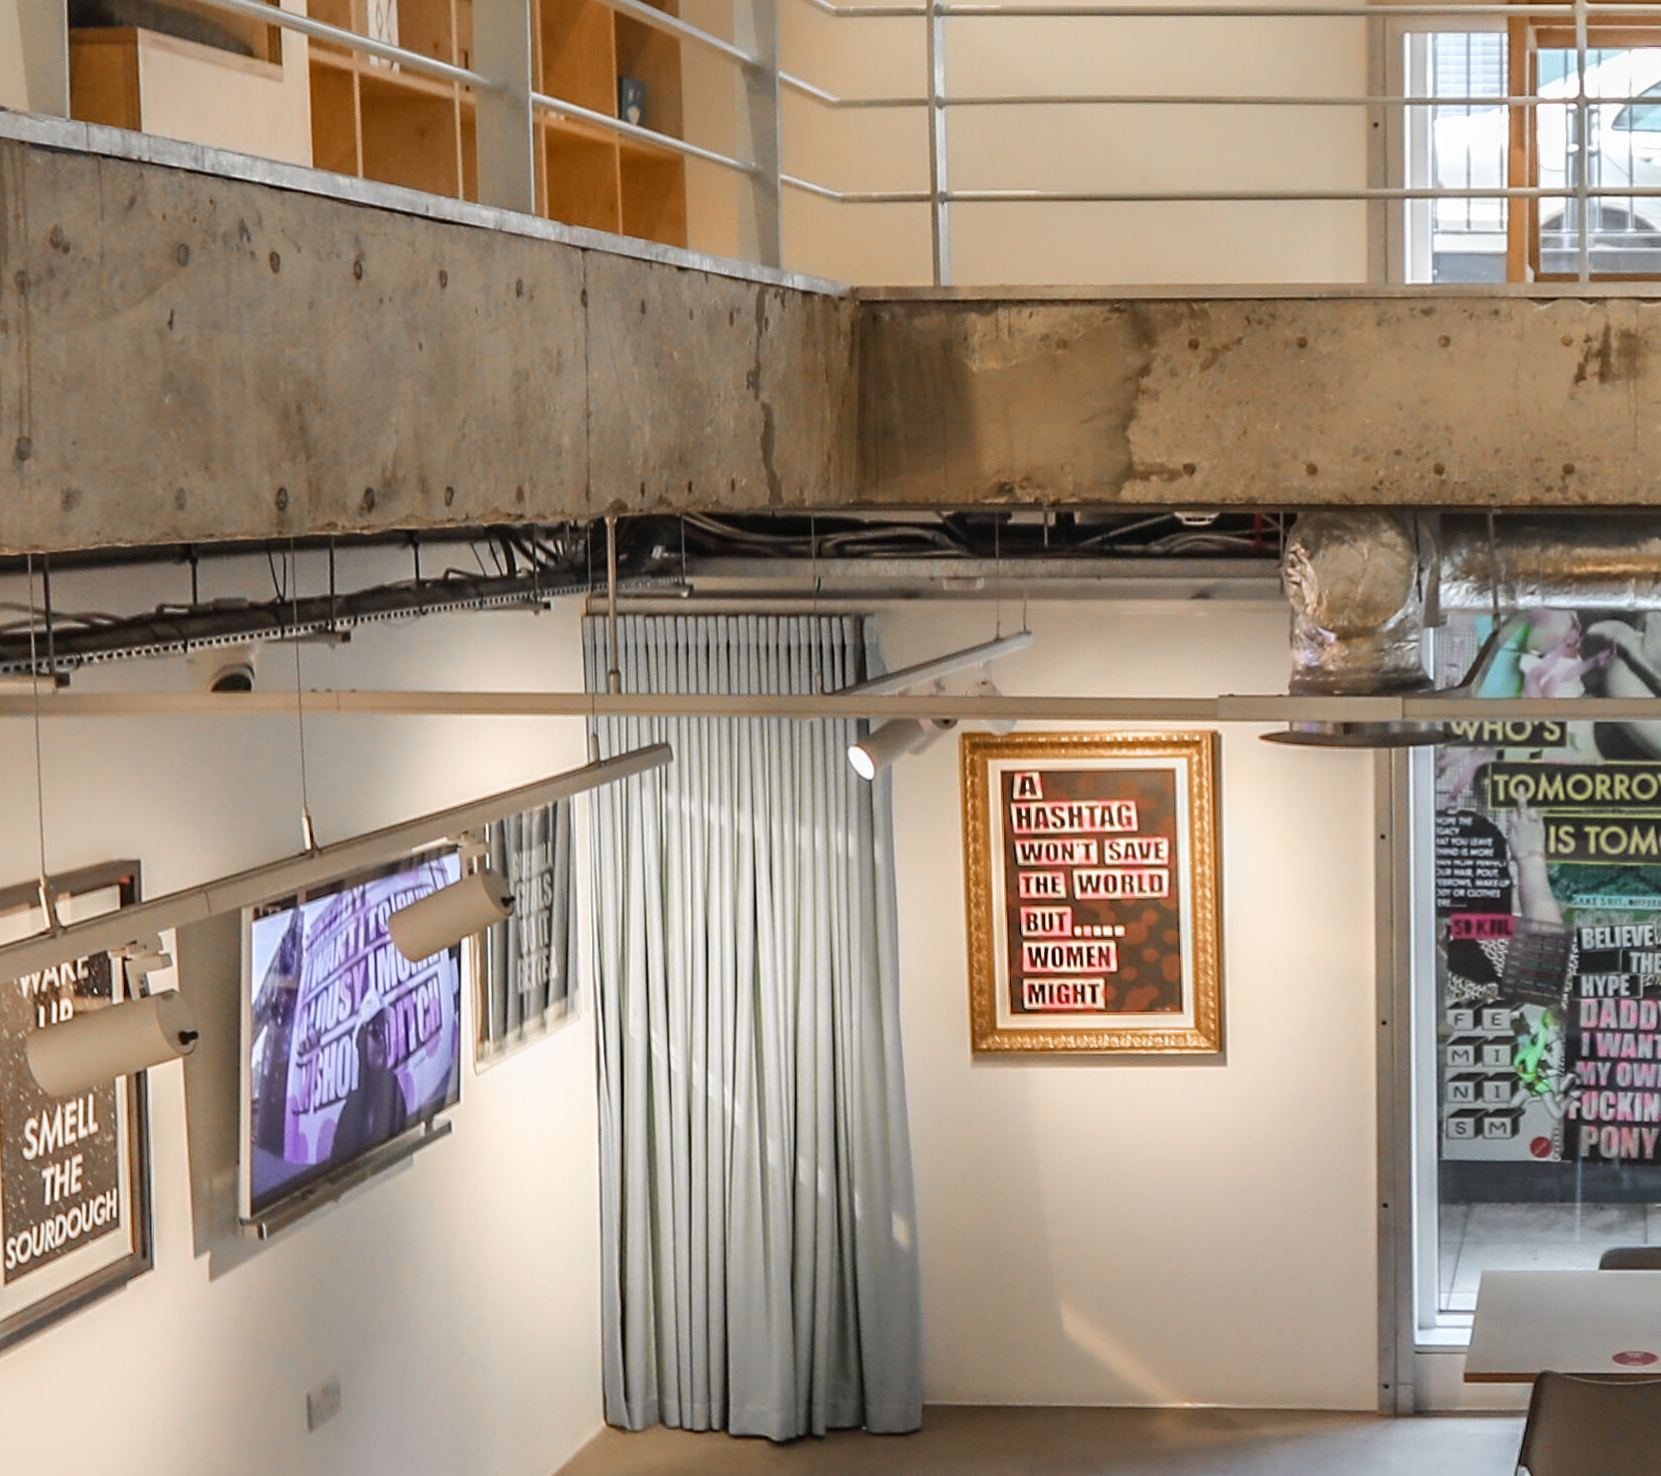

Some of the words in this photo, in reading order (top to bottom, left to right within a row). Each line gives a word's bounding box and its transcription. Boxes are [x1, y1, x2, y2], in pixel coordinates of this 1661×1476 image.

[1019, 776, 1037, 796] A
[1015, 803, 1135, 830] HASHTAG
[1019, 841, 1095, 862] WON'T
[1107, 841, 1166, 861] SAVE
[1548, 825, 1576, 855] IS
[1022, 875, 1062, 896] THE
[1077, 873, 1164, 895] WORLD
[1581, 924, 1655, 950] BELIEVE
[1027, 945, 1112, 968] WOMEN
[1027, 982, 1100, 1005] MIGHT
[1580, 974, 1631, 998] HYPE
[1580, 1032, 1591, 1058] I
[1575, 1061, 1612, 1087] MY
[22, 1093, 99, 1163] SMELL
[1580, 1125, 1660, 1159] PONY
[40, 1154, 84, 1206] THE
[5, 1188, 119, 1271] SOURDOUGH
